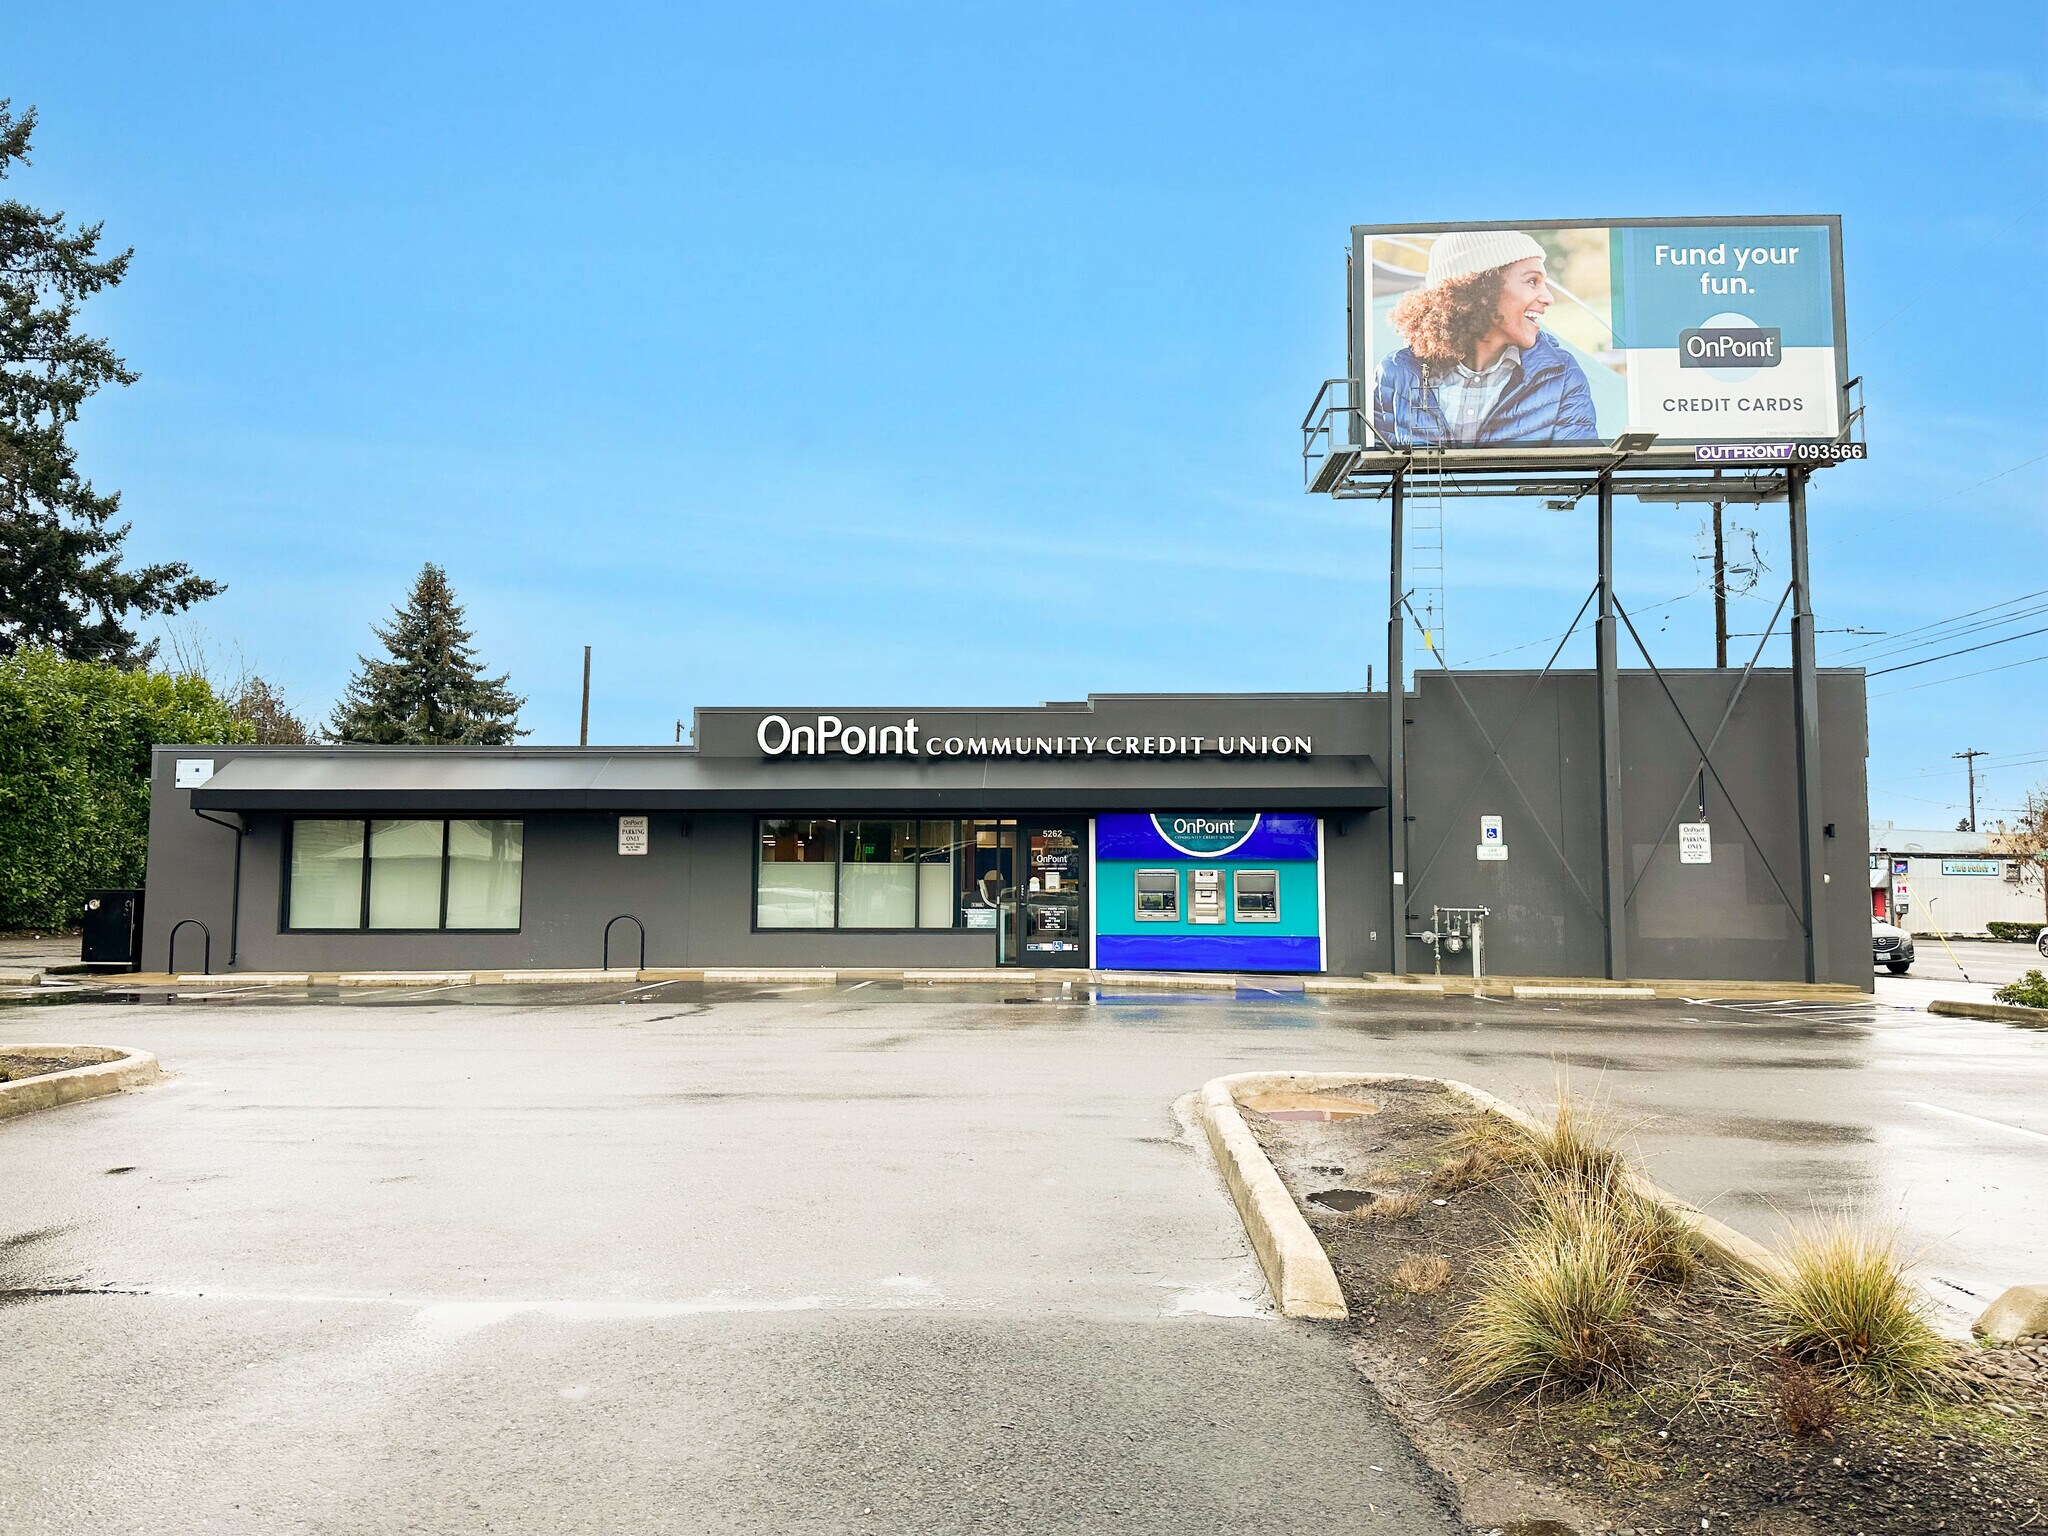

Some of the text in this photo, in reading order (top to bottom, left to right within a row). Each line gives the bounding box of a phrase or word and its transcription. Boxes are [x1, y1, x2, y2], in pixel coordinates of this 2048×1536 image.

[1655, 243, 1800, 272] Fund your
[1699, 271, 1756, 295] fun.
[1686, 335, 1774, 358] OnPoint
[1662, 397, 1804, 412] CREDIT CARDS
[1698, 444, 1863, 459] OUTFRONT 093566
[757, 714, 1313, 756] OnPoint COMMUNITY CREDIT UNION
[1042, 829, 1063, 838] 5262
[1173, 818, 1236, 834] OnPoint
[1036, 854, 1068, 863] OnPoint
